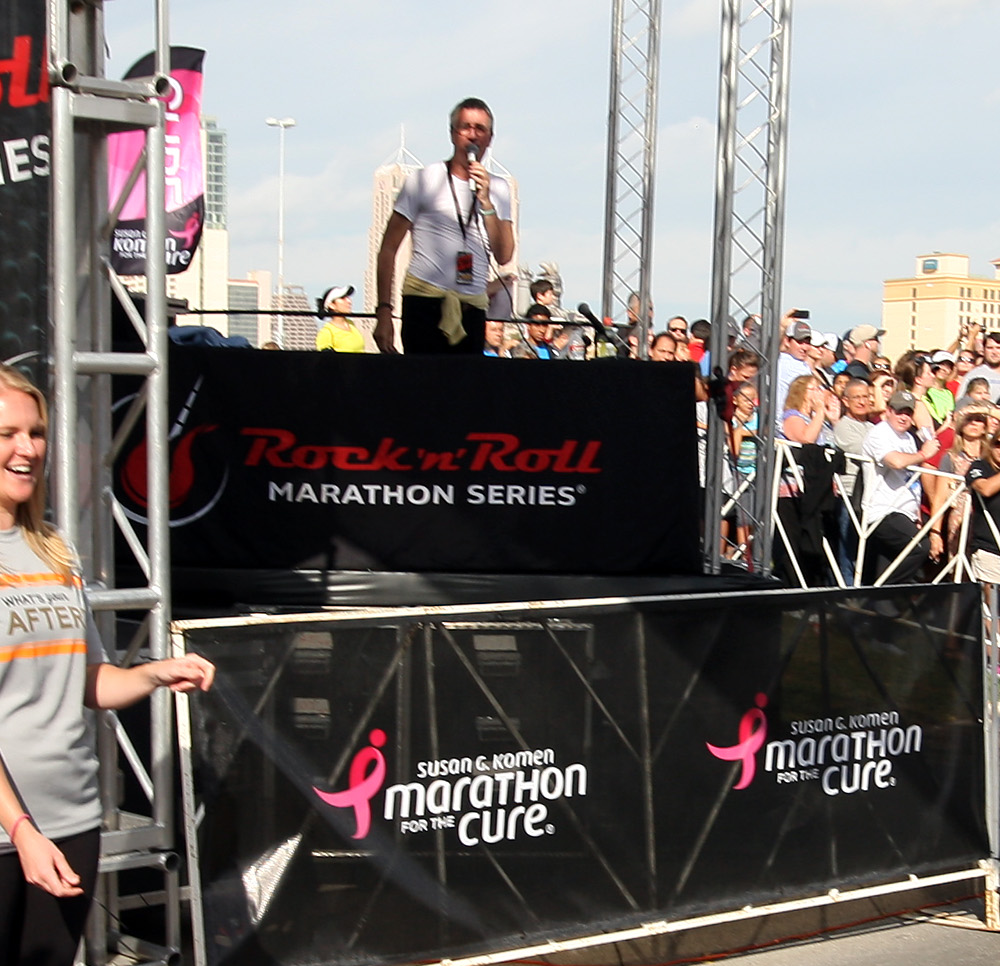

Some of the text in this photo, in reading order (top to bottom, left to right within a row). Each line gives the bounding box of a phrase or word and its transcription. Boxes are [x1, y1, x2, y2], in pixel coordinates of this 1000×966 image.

[113, 237, 177, 252] Komn
[240, 427, 413, 471] Rock
[465, 432, 603, 474] Roll
[268, 480, 577, 507] MARATHON SERIES
[7, 605, 86, 636] AFTER
[400, 819, 429, 835] FOR
[430, 815, 456, 830] THE
